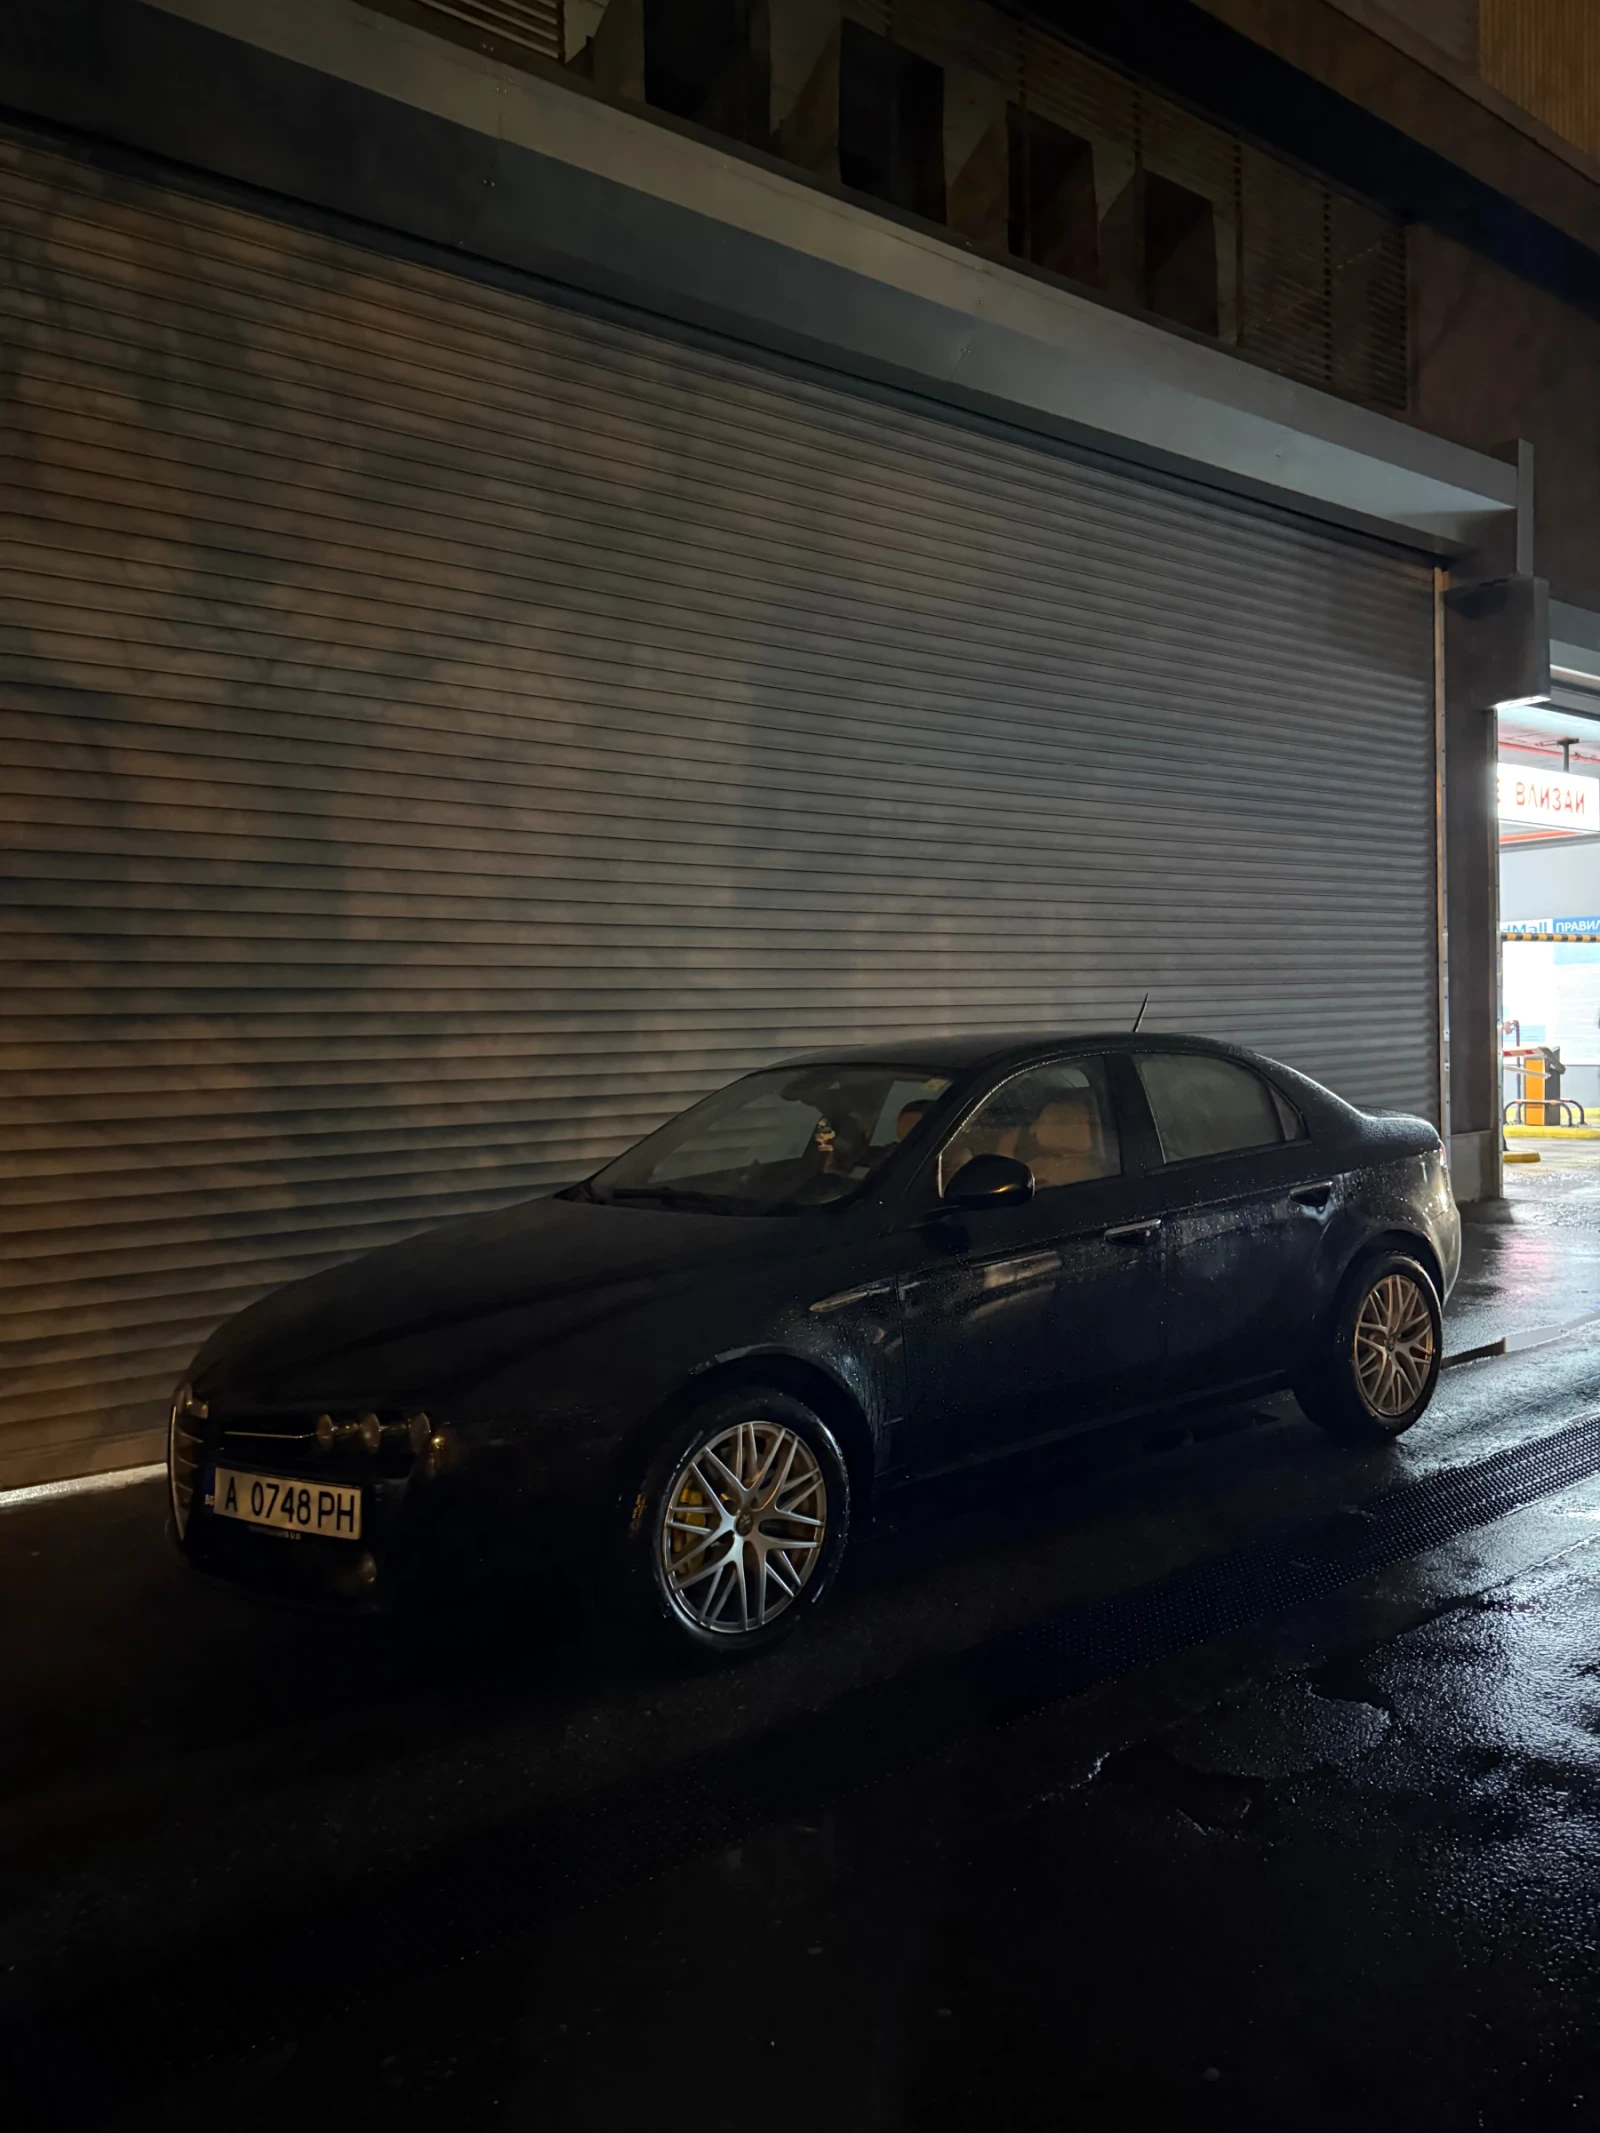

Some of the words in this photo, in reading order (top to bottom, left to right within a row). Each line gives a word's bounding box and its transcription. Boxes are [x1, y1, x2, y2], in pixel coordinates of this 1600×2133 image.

[224, 1476, 238, 1512] A
[251, 1481, 311, 1526] 0748
[318, 1491, 355, 1533] PH
